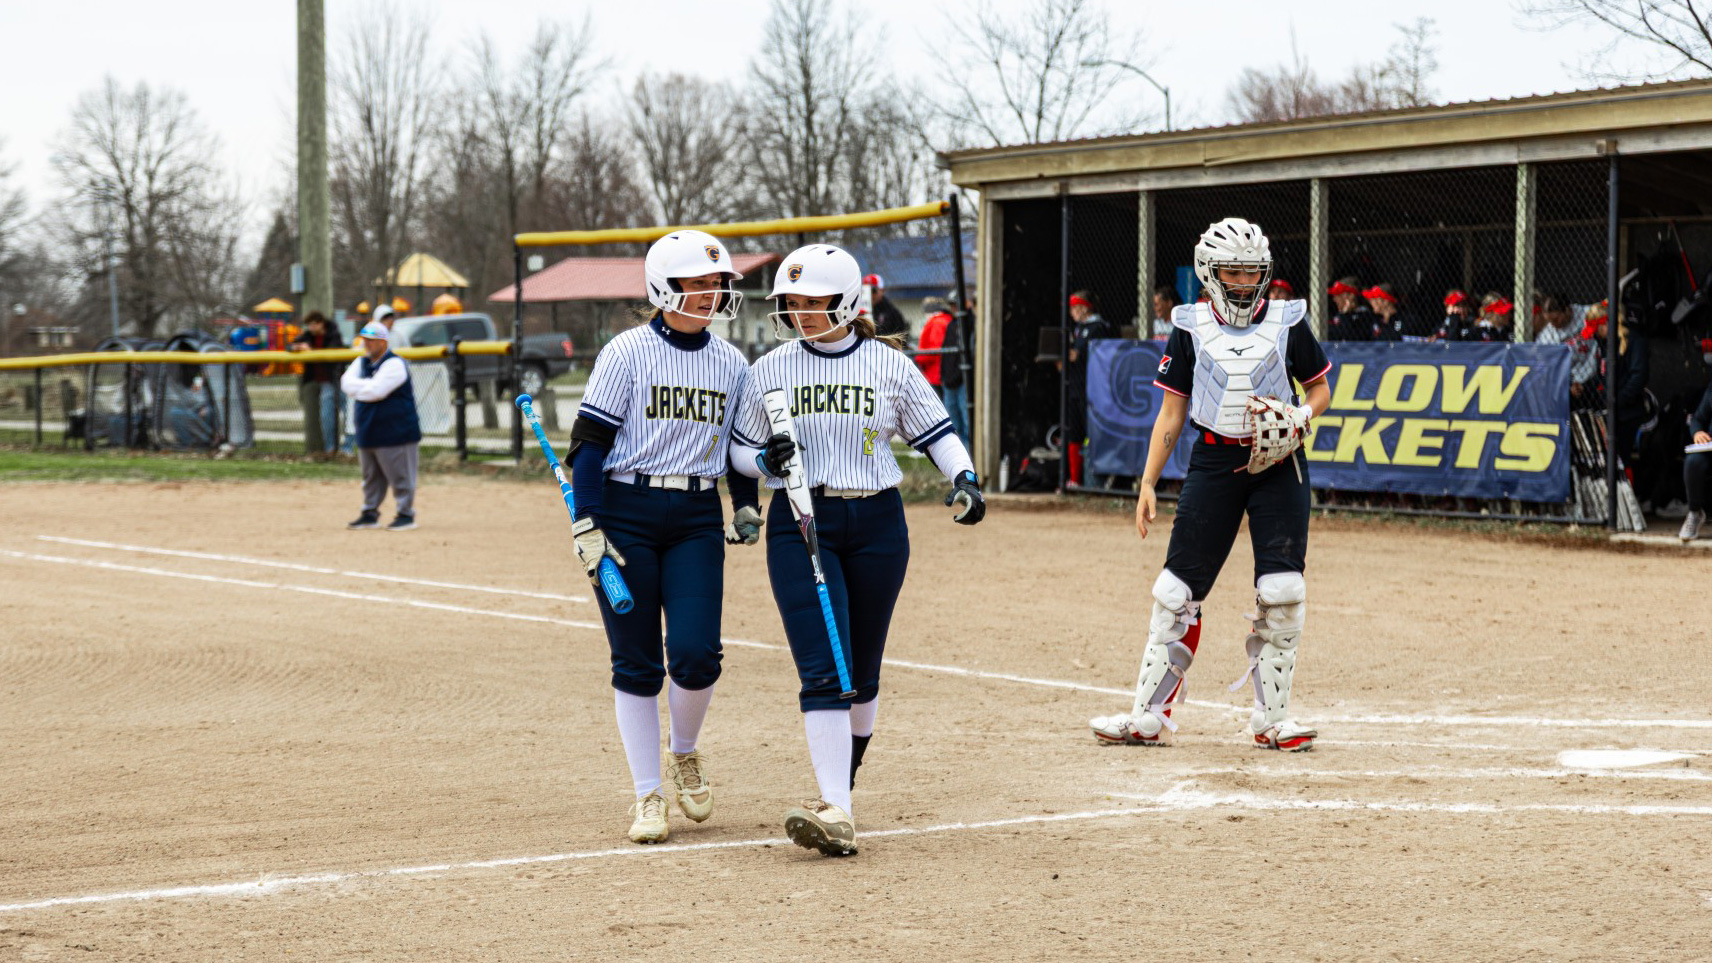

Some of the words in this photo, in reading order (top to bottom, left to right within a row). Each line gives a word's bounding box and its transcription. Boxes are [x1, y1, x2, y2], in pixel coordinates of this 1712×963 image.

[706, 246, 720, 261] G
[788, 266, 802, 281] G
[645, 384, 727, 426] JACKETS
[790, 384, 875, 418] JACKETS
[1296, 363, 1530, 414] LOW
[1306, 416, 1560, 472] CKETS
